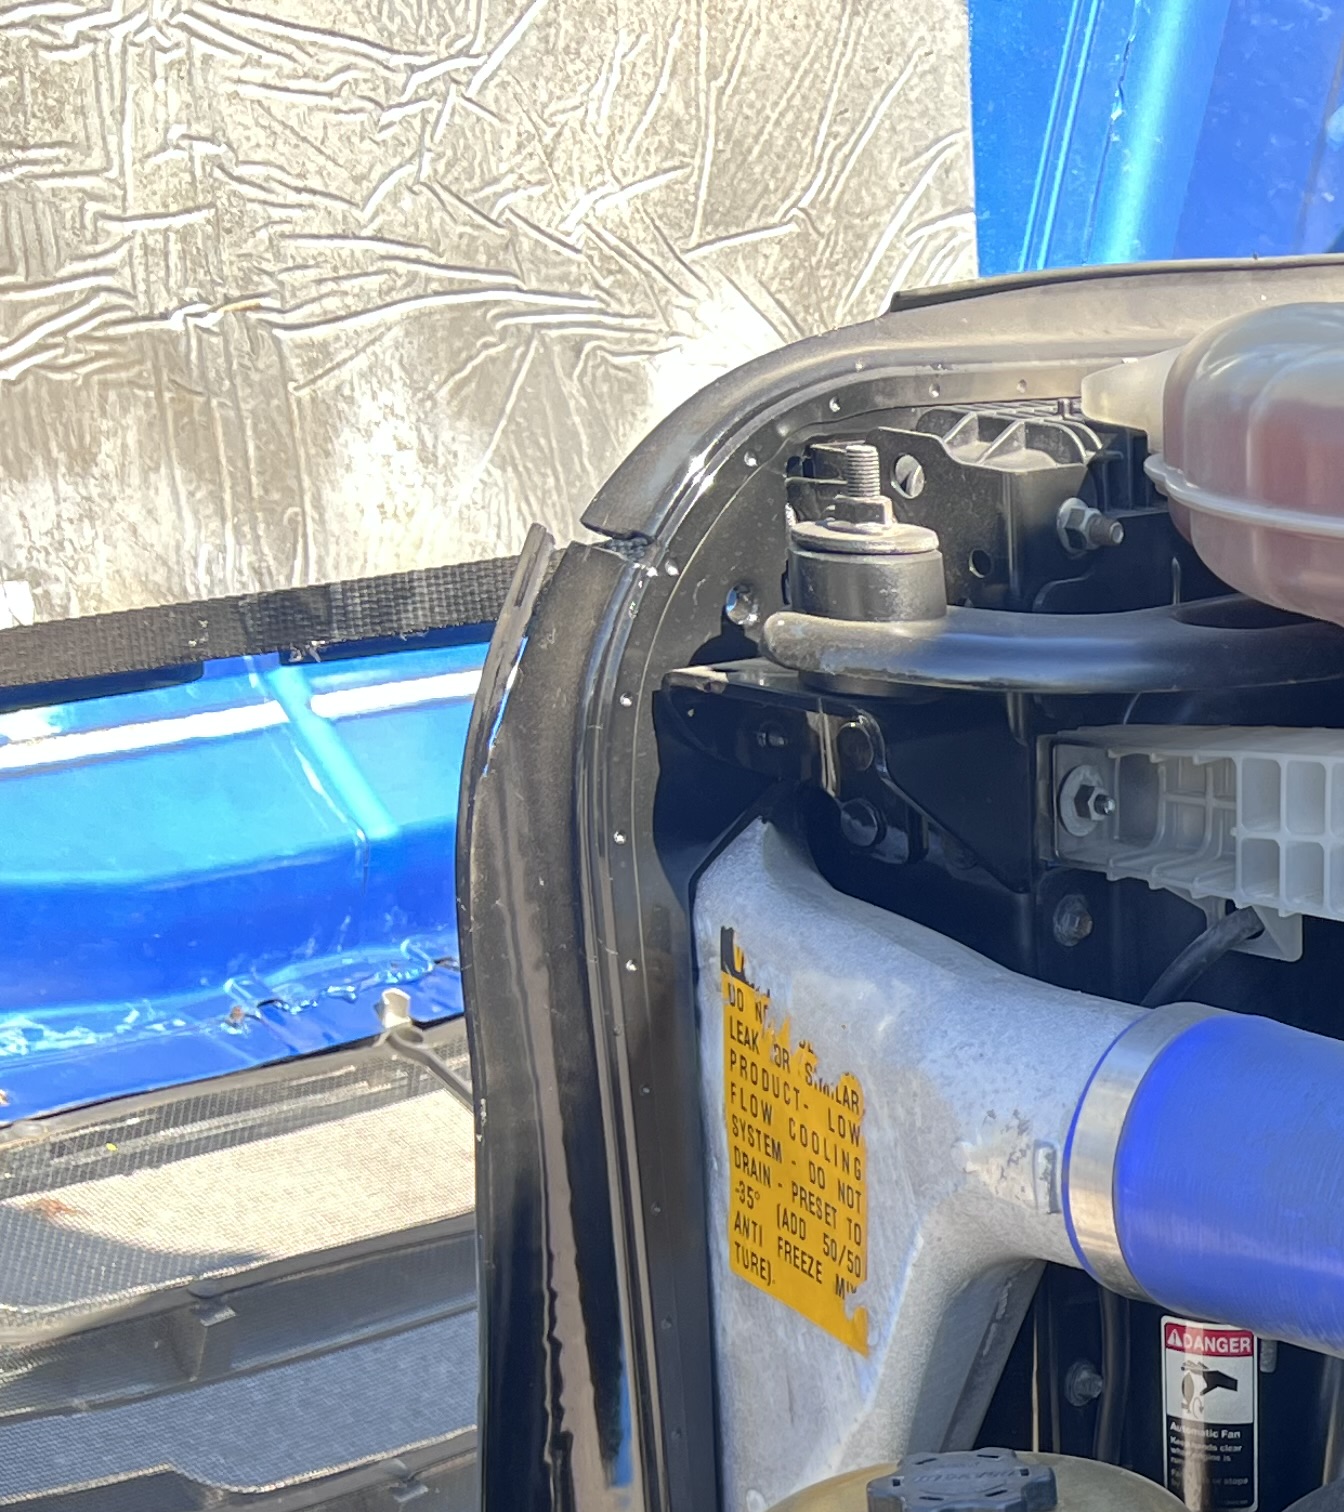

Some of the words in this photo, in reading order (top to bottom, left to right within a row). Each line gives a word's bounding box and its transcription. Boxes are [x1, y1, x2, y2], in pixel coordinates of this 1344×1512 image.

[730, 1016, 760, 1055] LEAK
[773, 1043, 791, 1074] OR
[730, 1081, 772, 1126] FLOW
[788, 1117, 862, 1181] COOLING
[828, 1108, 861, 1147] LOW
[732, 1114, 782, 1163] SYSTEM
[808, 1160, 825, 1190] DO
[838, 1179, 862, 1214] NOT
[734, 1145, 771, 1188] DRAIN
[791, 1181, 837, 1230] PRESET
[846, 1217, 862, 1247] TO
[734, 1211, 762, 1247] ANTI
[777, 1236, 822, 1284] FREEZE
[776, 1203, 806, 1240] (ADD
[822, 1233, 861, 1278] 50/50
[1182, 1333, 1251, 1353] DANGER
[1170, 1421, 1218, 1439] Automatic
[1221, 1429, 1241, 1439] Fan
[1220, 1444, 1242, 1452] clear
